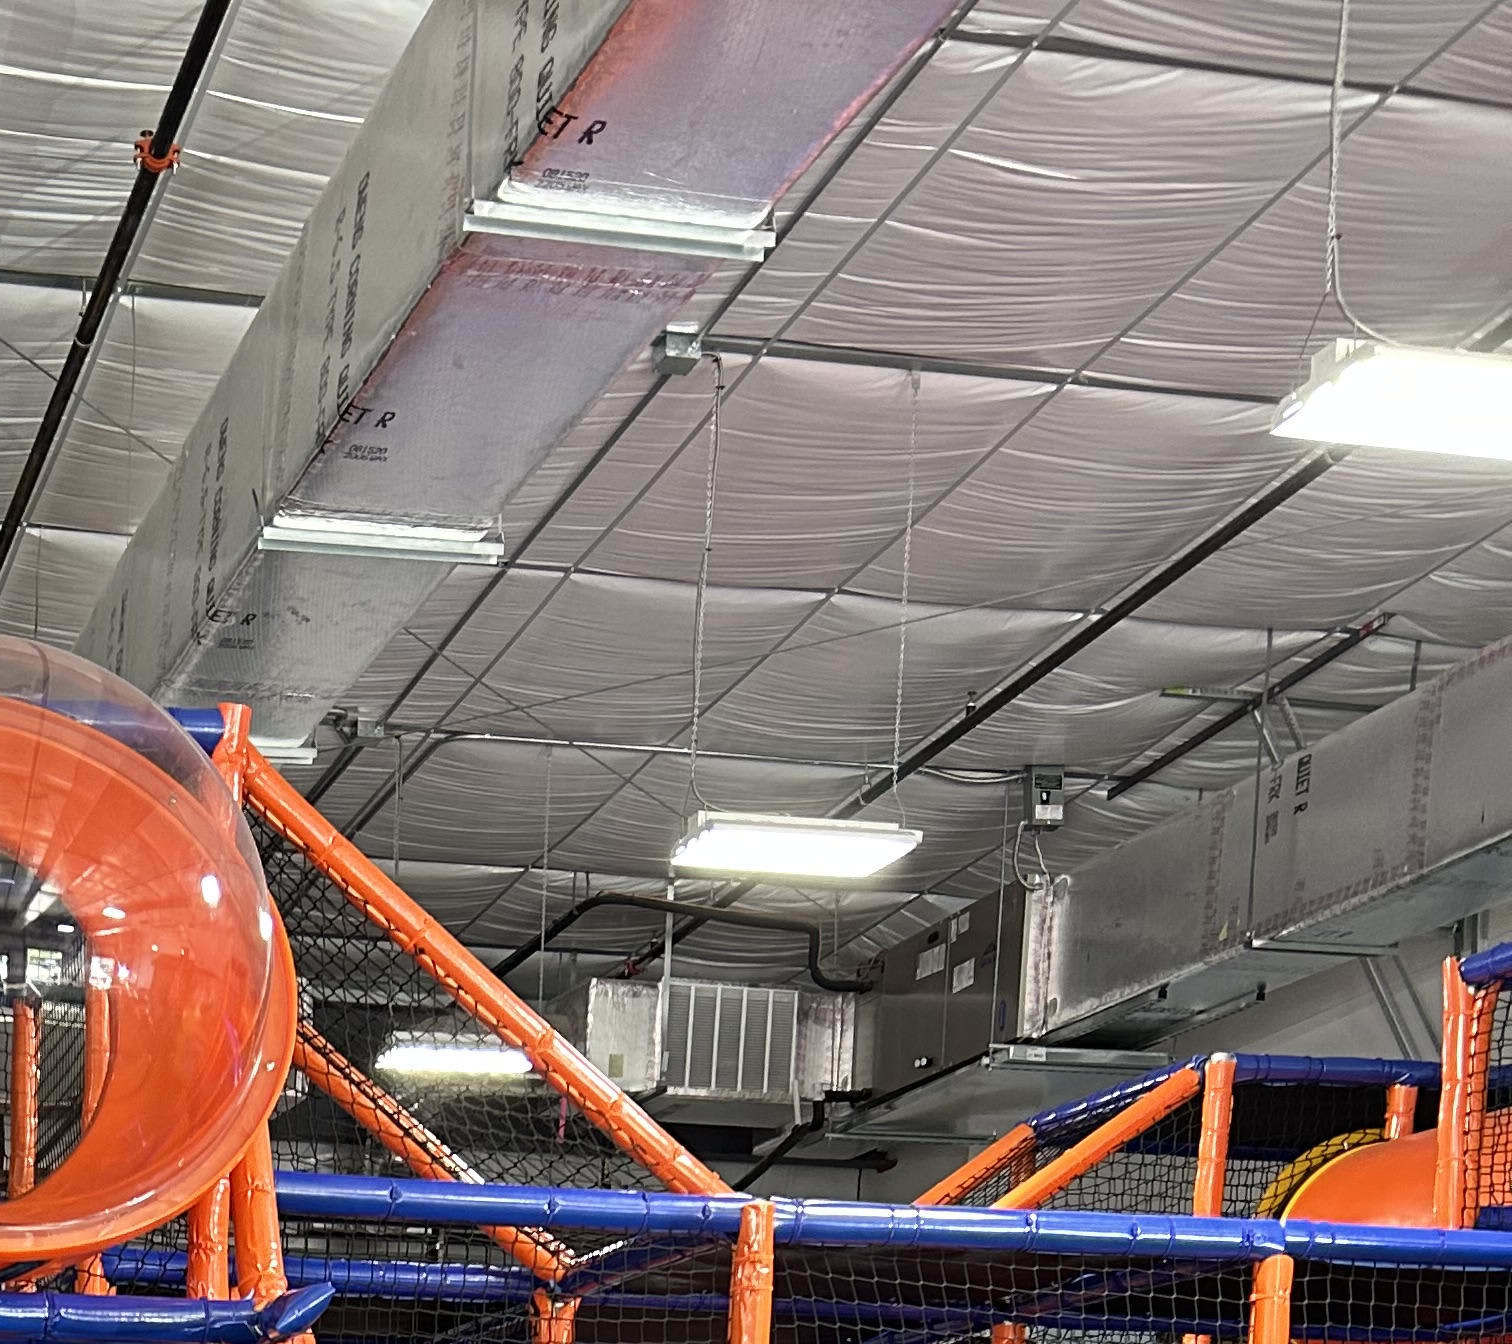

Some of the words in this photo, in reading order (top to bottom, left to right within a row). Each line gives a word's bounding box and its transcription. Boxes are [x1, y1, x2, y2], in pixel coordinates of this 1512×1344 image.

[535, 56, 579, 139] QUIET
[578, 120, 607, 144] R
[336, 363, 375, 424] QUIET
[374, 411, 396, 429] R
[240, 613, 257, 626] R
[1294, 753, 1312, 797] QUIET
[1293, 801, 1309, 815] R
